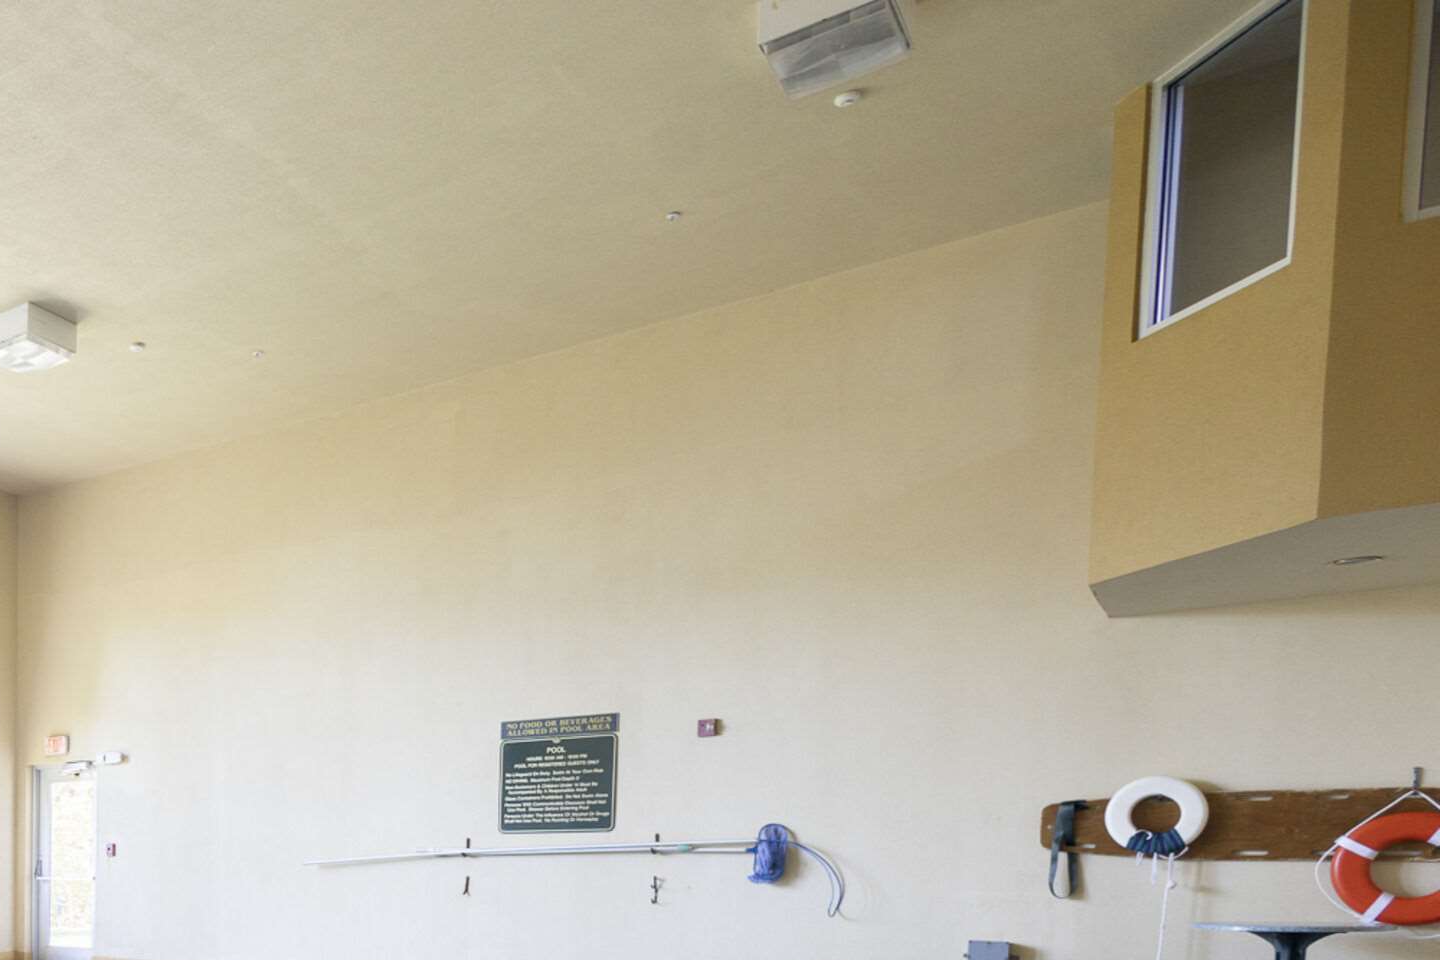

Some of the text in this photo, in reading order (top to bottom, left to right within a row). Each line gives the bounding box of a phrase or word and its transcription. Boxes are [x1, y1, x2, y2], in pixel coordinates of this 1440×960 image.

[519, 721, 543, 729] FOOD
[560, 716, 612, 725] BEVERAGES
[507, 728, 547, 736] ALLOWED
[560, 725, 582, 733] POOL
[587, 723, 611, 731] AREA
[546, 746, 566, 754] POOL
